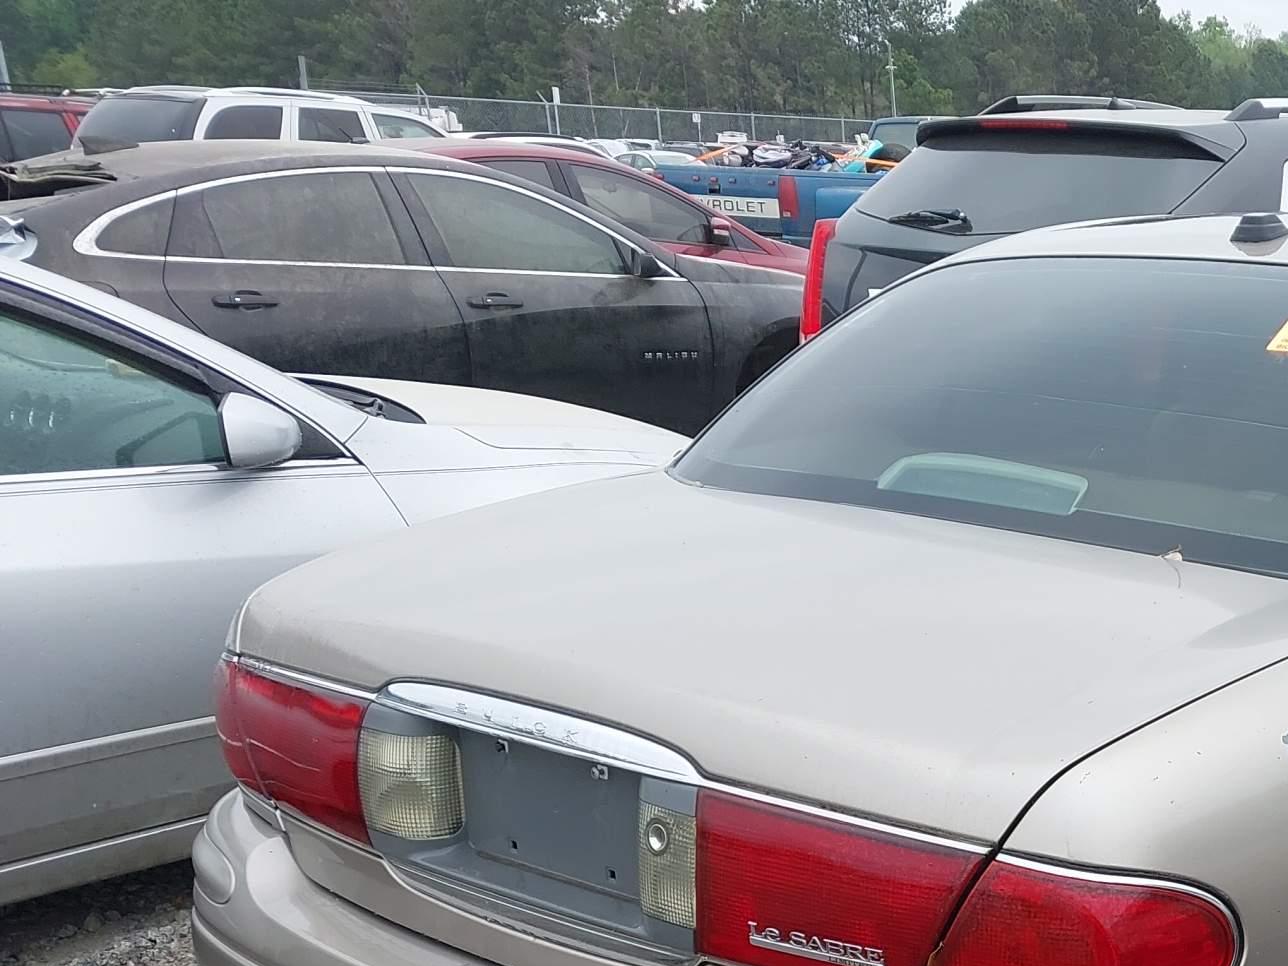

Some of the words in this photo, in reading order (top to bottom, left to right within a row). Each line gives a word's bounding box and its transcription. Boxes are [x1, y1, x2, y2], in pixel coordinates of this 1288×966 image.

[455, 702, 579, 743] BUICK
[748, 921, 780, 941] Le
[789, 931, 885, 963] SABRE
